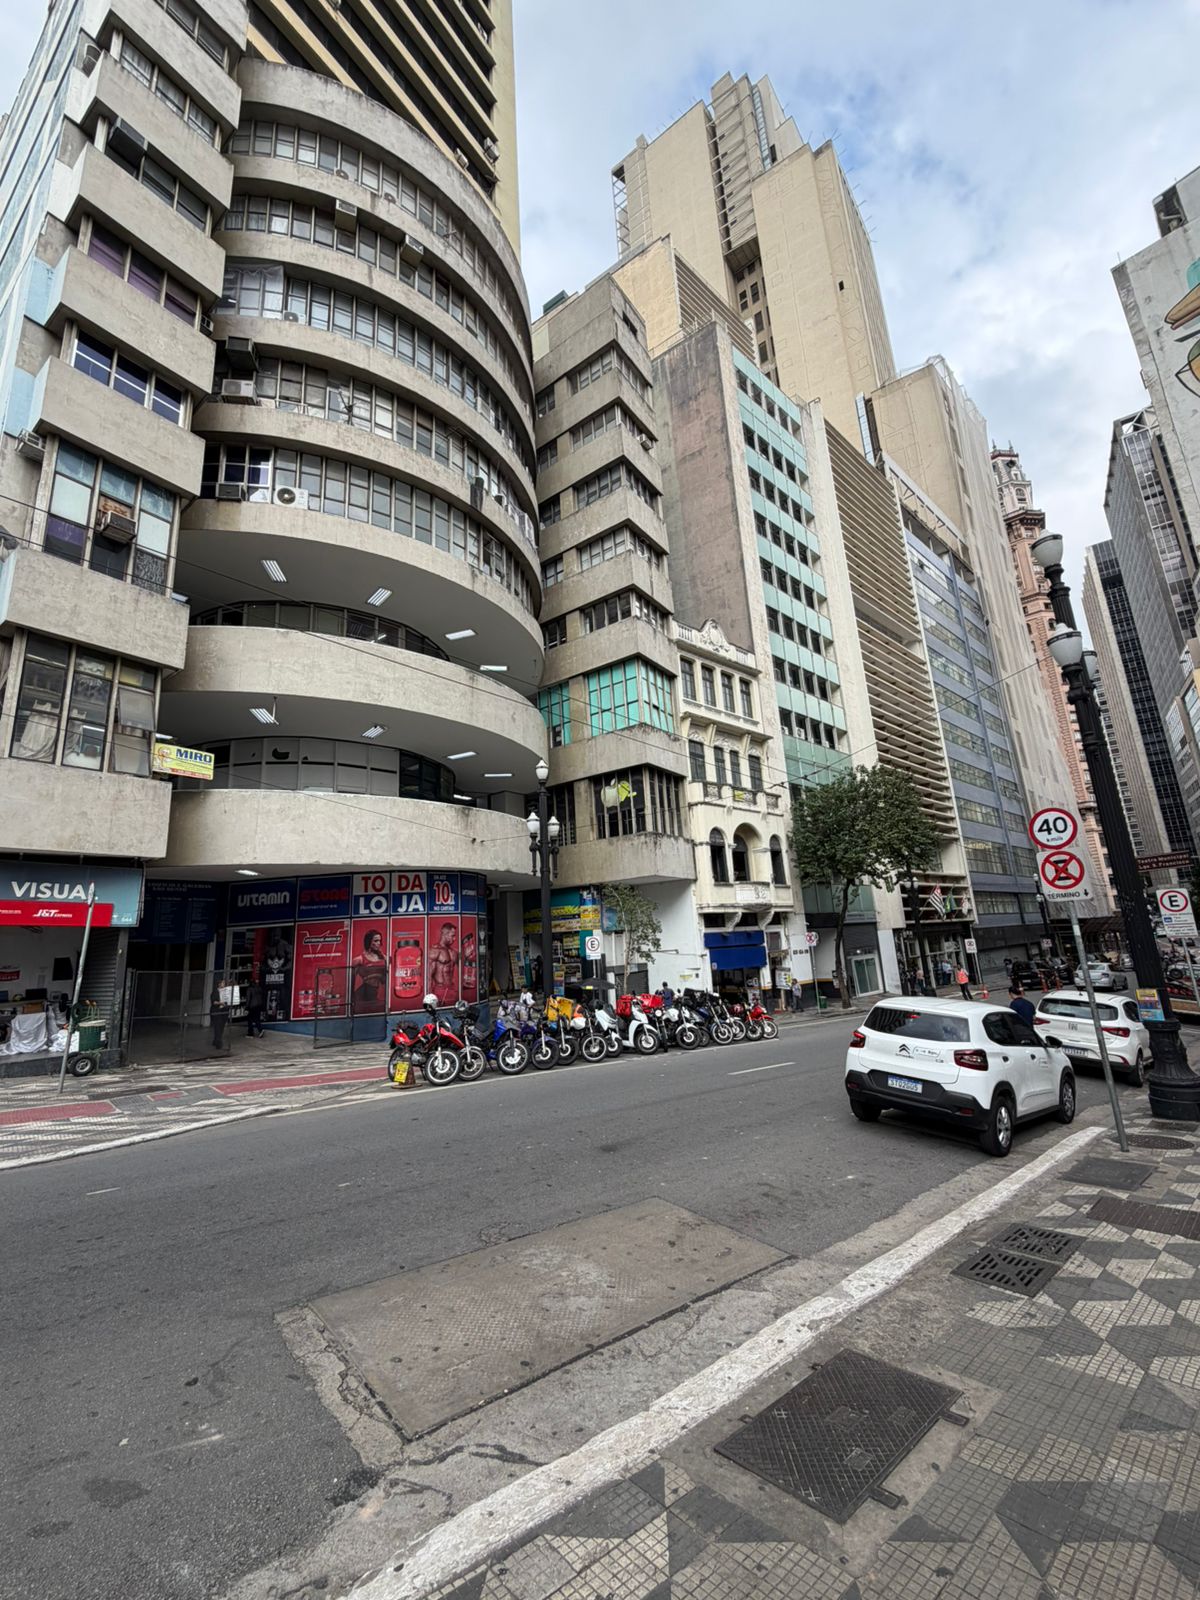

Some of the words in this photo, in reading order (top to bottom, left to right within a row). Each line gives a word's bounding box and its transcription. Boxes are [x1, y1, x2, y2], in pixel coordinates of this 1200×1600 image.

[176, 749, 212, 763] MIRO
[1037, 817, 1068, 835] 40
[11, 881, 99, 900] VISUA
[237, 891, 290, 907] VITAMIN
[1168, 895, 1180, 907] E
[591, 940, 596, 948] E
